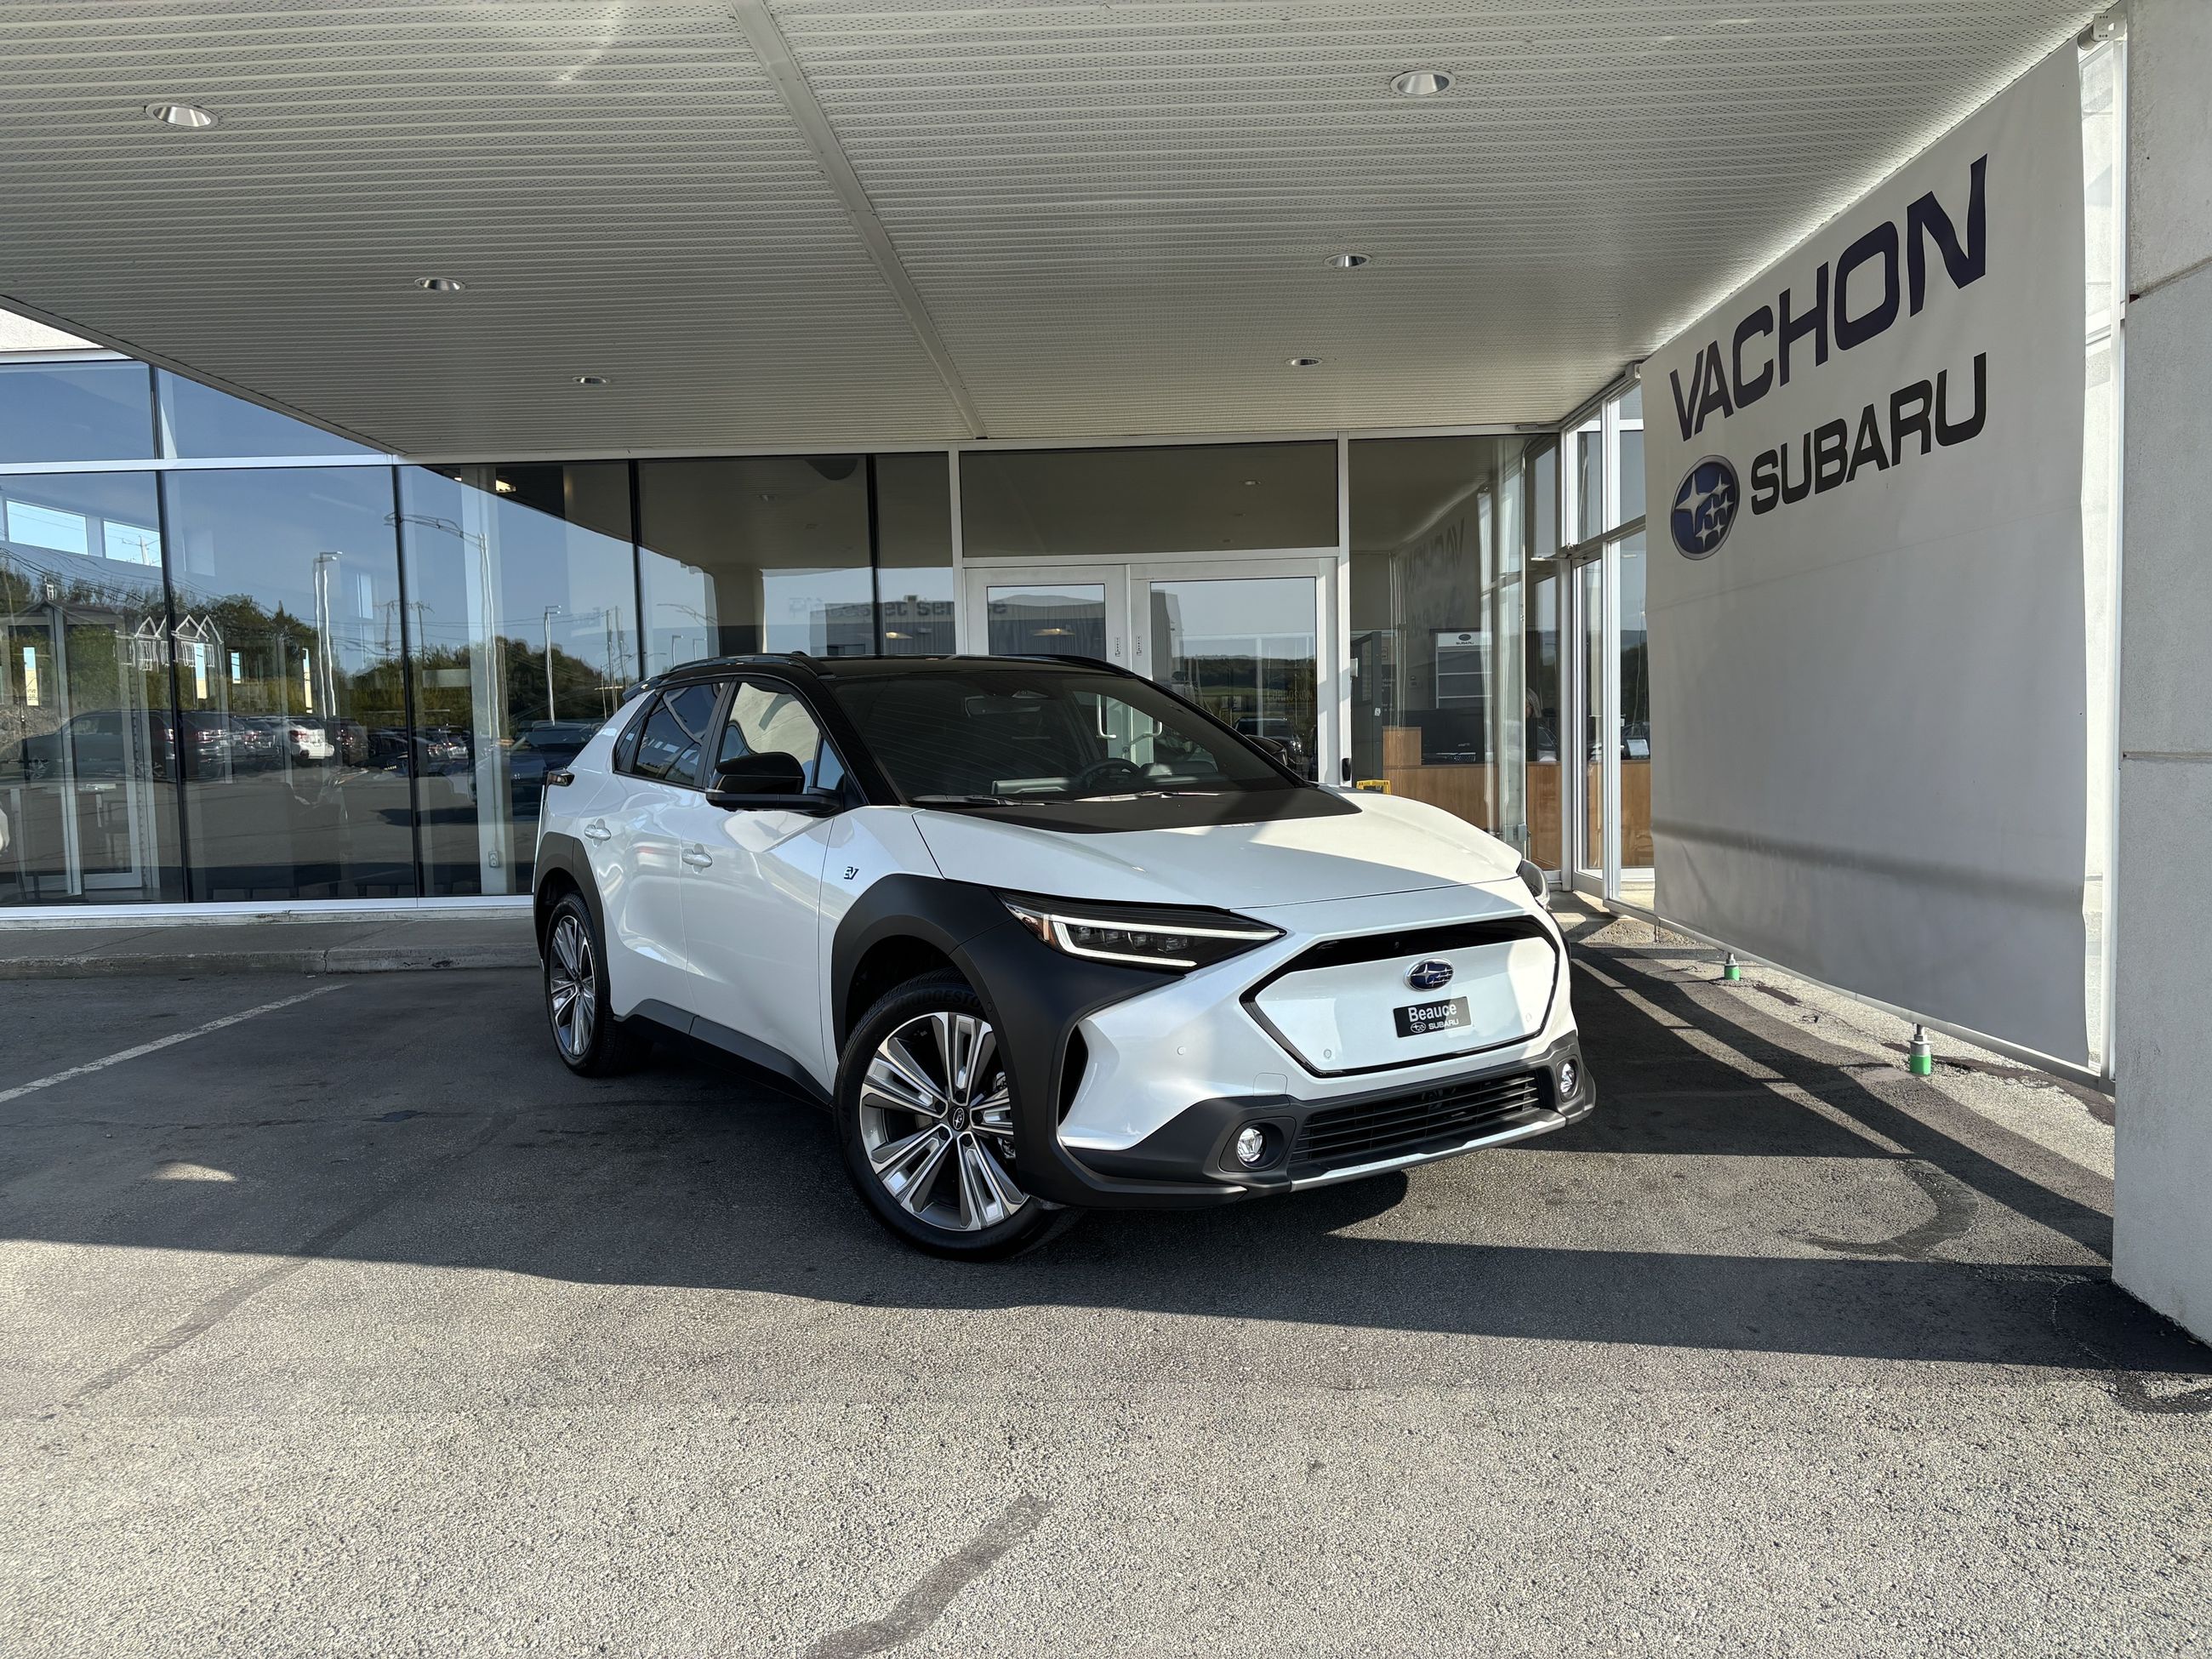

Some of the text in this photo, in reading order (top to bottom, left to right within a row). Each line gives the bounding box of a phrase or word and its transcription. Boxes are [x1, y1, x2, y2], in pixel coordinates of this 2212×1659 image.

[1669, 153, 1987, 442] VACHON
[1751, 351, 1987, 515] SUBARU
[1408, 1004, 1457, 1022] Beauce
[1428, 1018, 1459, 1030] SUBARU
